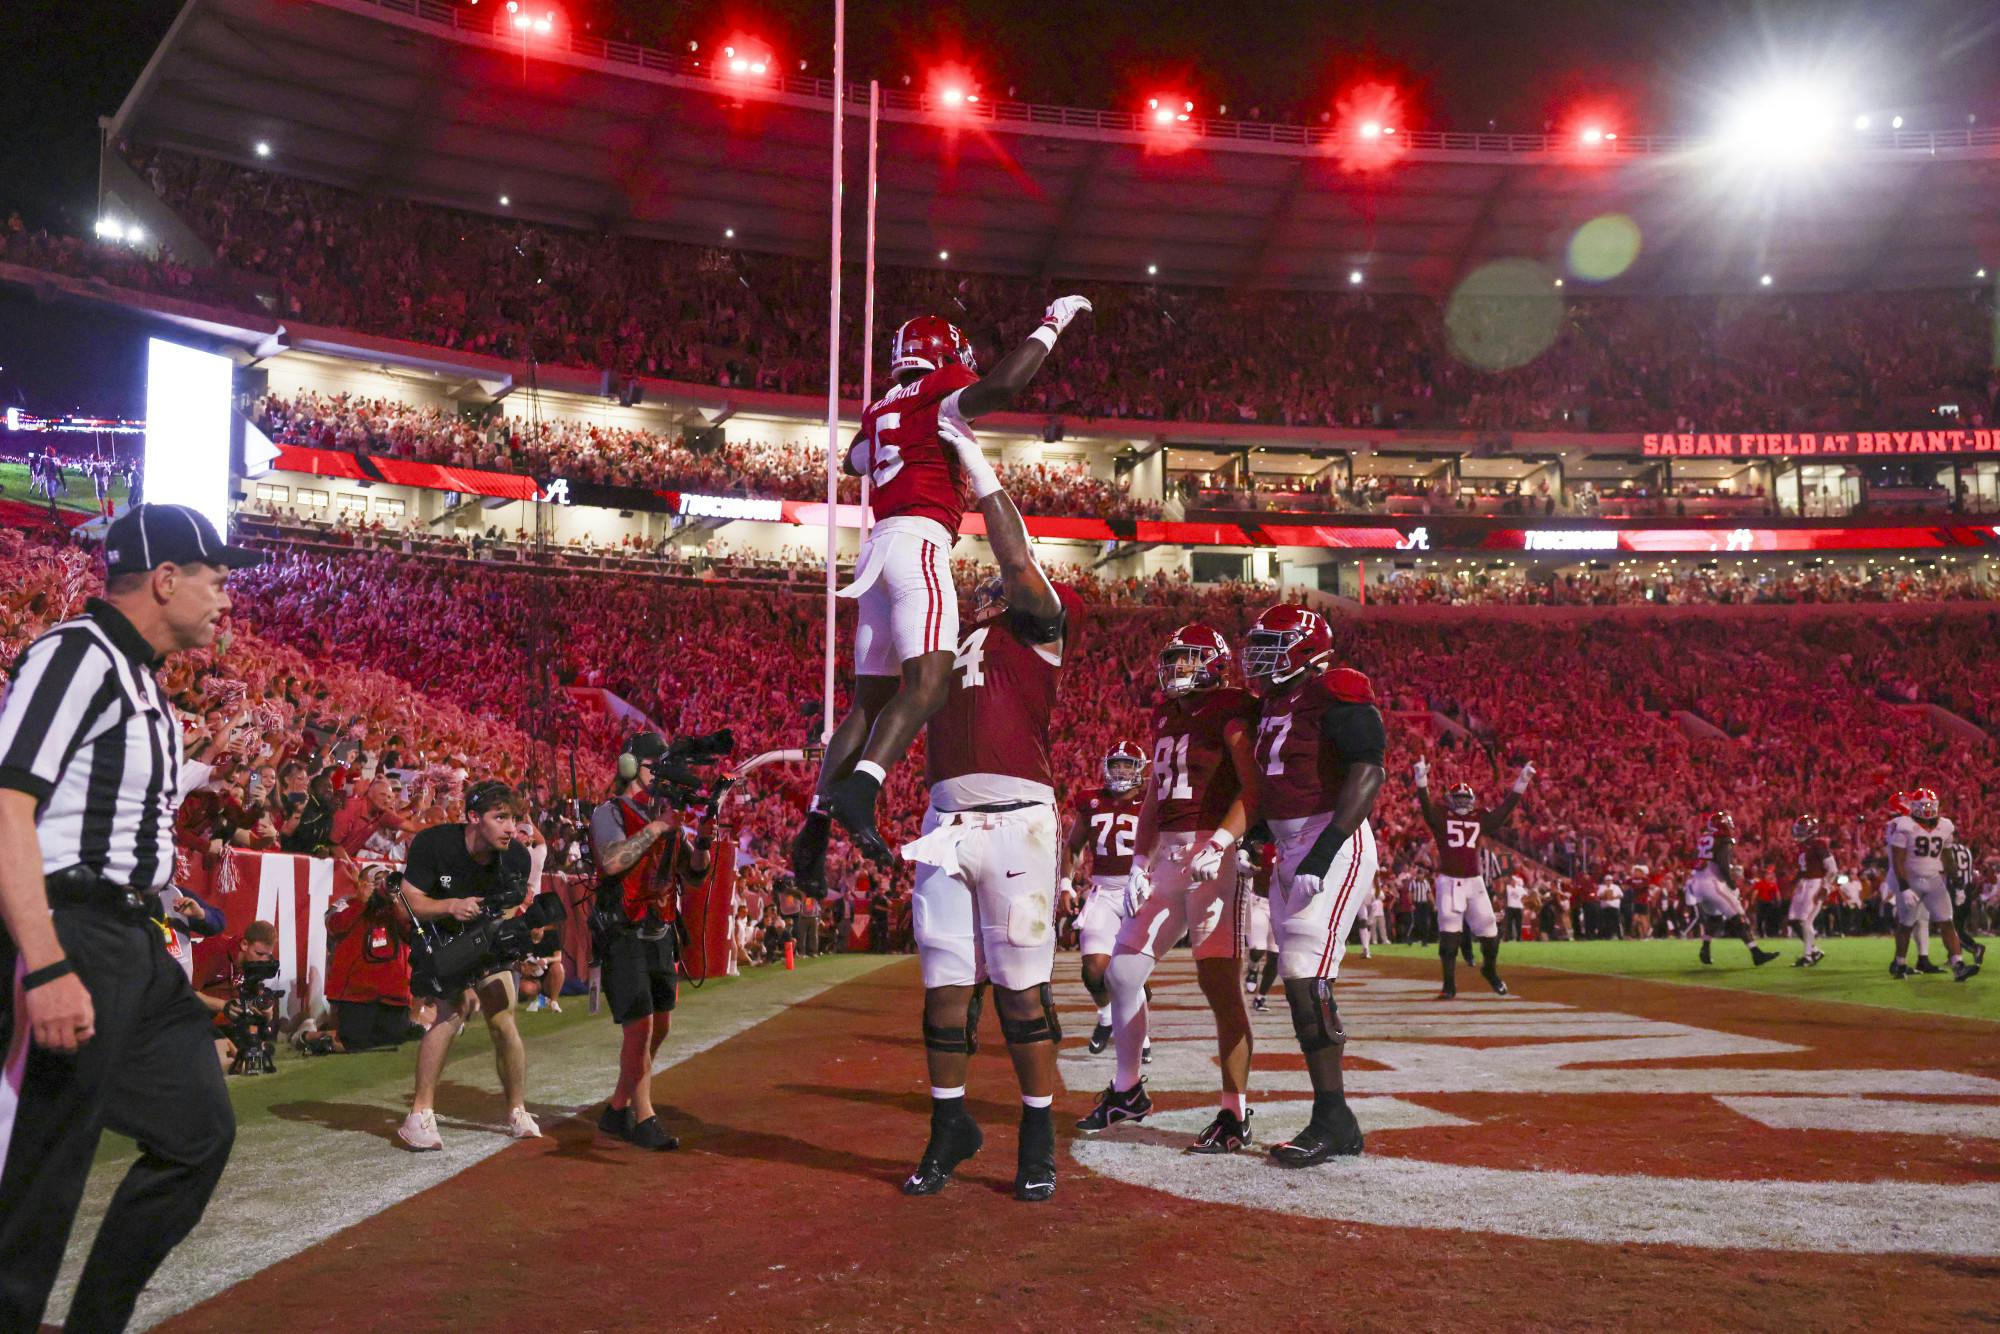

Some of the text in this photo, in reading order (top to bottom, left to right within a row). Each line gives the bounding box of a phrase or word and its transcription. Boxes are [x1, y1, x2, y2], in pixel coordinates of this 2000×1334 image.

[873, 412, 904, 488] 5
[1643, 433, 1733, 456] SABAN
[1740, 433, 1817, 455] FIELD
[1822, 435, 1850, 452] AT
[1296, 609, 1316, 629] 77
[1152, 733, 1193, 800] 81
[1090, 812, 1139, 857] 72
[1446, 819, 1481, 849] 57
[1913, 835, 1944, 858] 93
[1957, 850, 1969, 870] C
